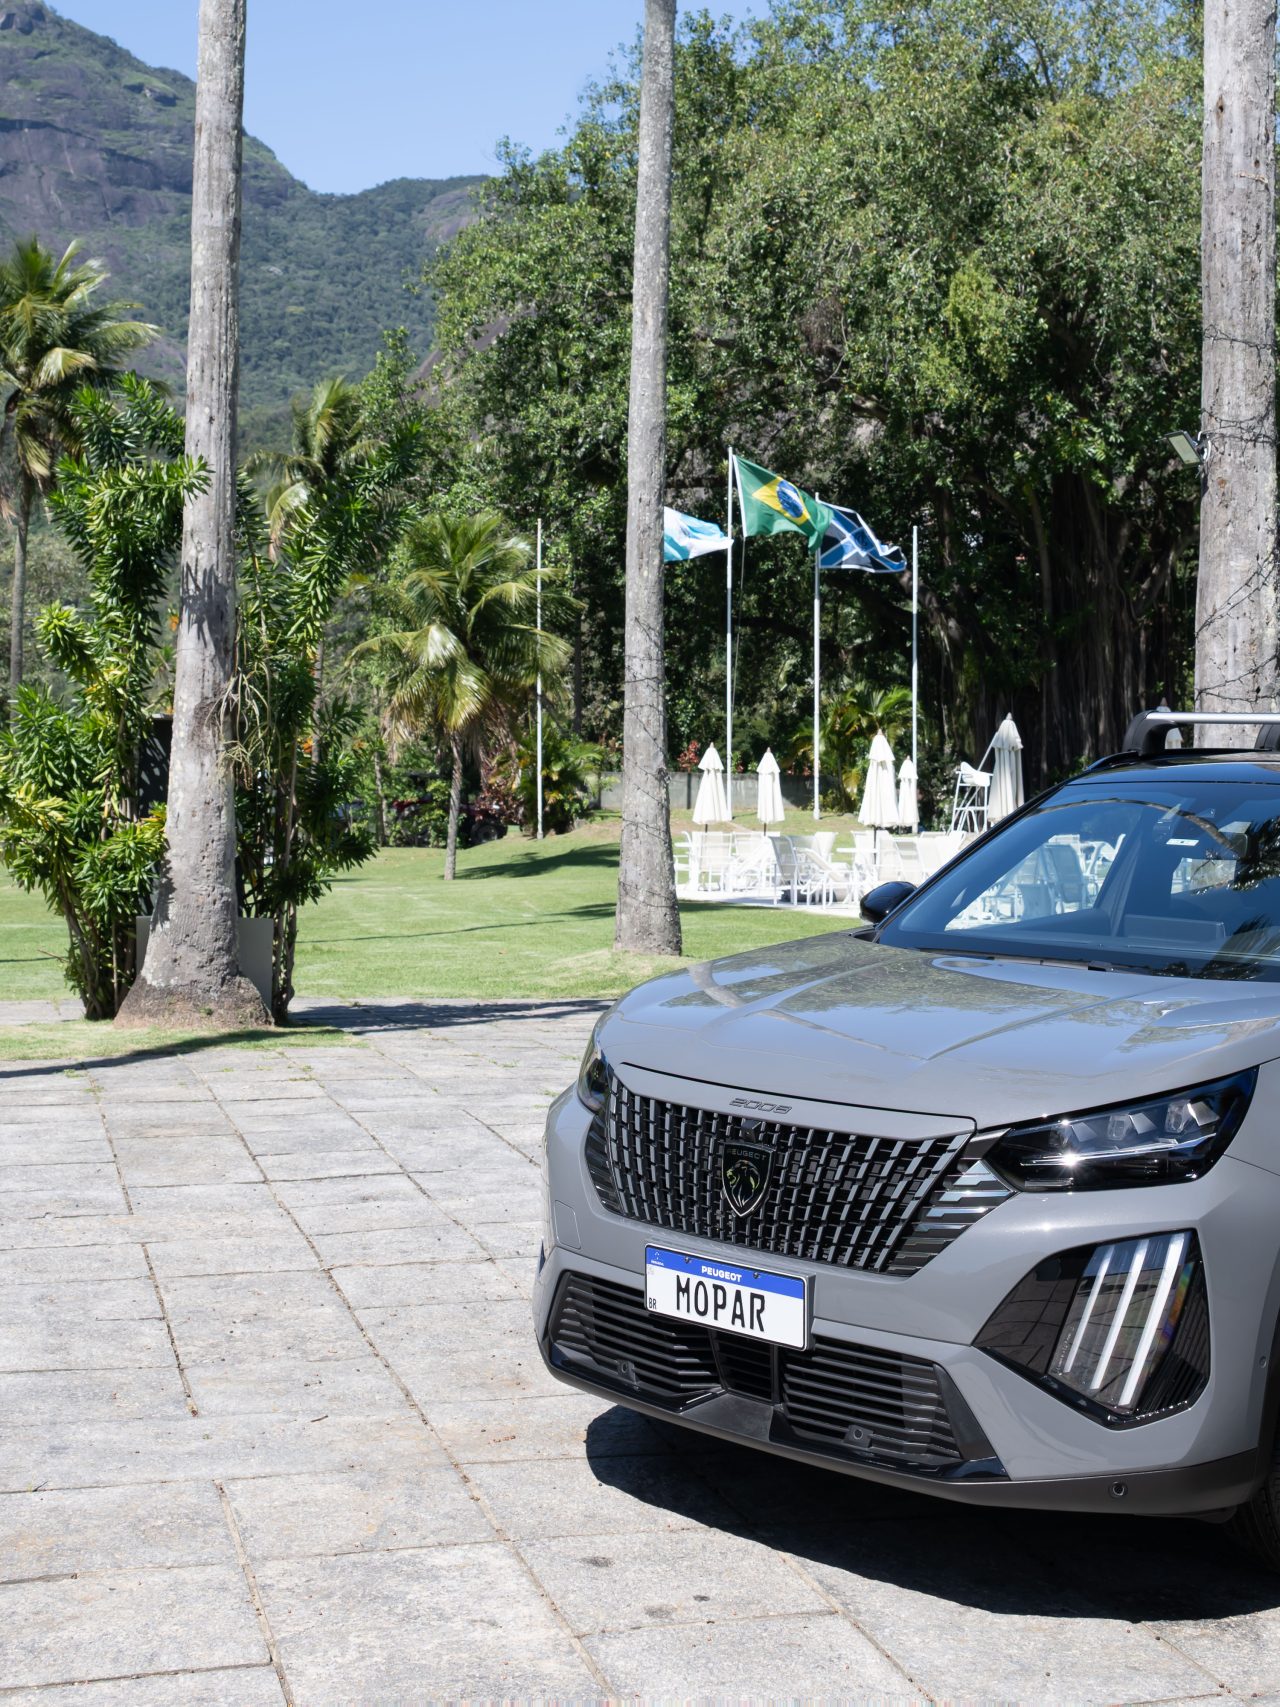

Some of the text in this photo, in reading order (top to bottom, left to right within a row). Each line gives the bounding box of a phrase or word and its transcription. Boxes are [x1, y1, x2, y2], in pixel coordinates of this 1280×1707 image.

[729, 1097, 793, 1115] 2008
[701, 1265, 743, 1283] PEUGEOT
[648, 1297, 657, 1310] BR
[676, 1274, 766, 1332] MOPAR
